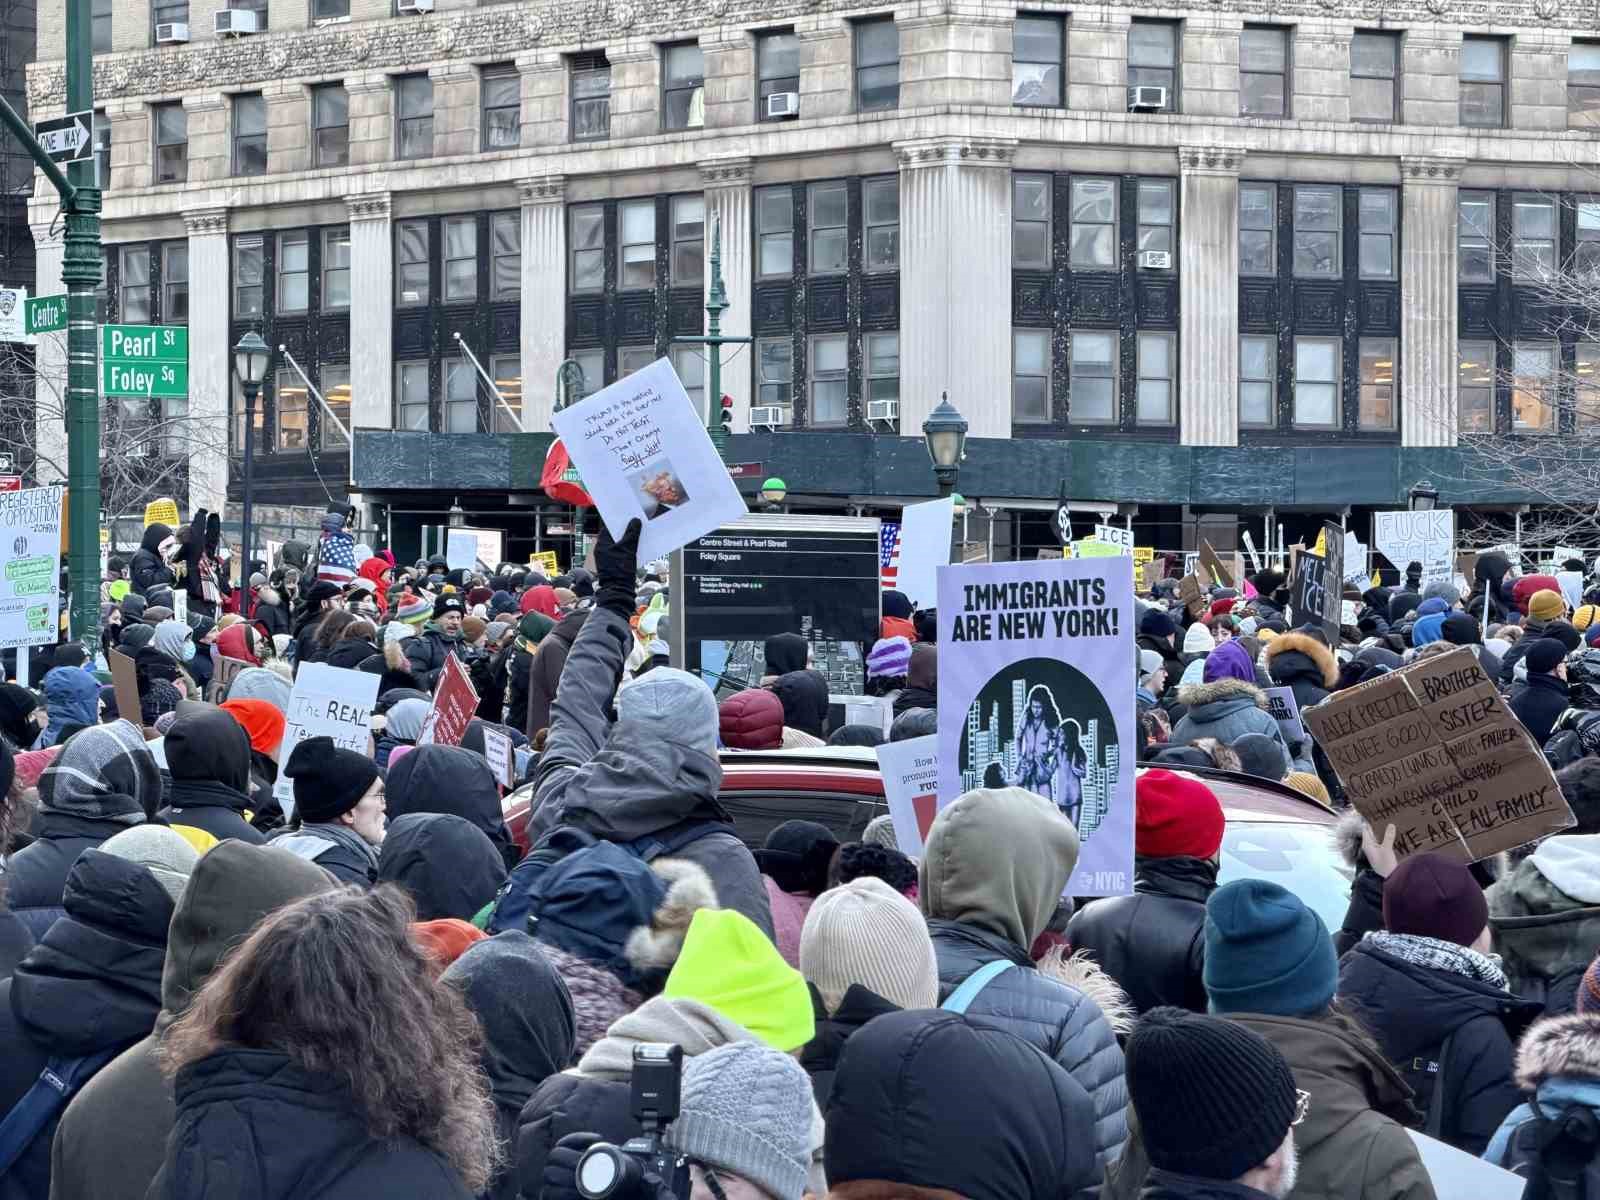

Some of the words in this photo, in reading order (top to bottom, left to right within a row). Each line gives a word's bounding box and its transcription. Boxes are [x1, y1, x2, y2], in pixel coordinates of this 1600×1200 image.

[40, 132, 57, 151] ONE
[64, 126, 81, 149] WAY
[32, 302, 59, 328] Centre
[60, 298, 67, 312] St
[112, 330, 156, 356] Pearl
[164, 330, 175, 345] St
[112, 366, 155, 396] Foley
[161, 366, 175, 384] Sq
[1100, 528, 1129, 546] ICE
[1378, 512, 1449, 541] FUCK
[700, 538, 722, 547] Centre
[723, 539, 743, 547] Street
[743, 539, 749, 547] &
[750, 540, 767, 548] Pearl
[767, 540, 788, 548] Street
[700, 552, 717, 562] Foley
[718, 552, 742, 562] Square
[1390, 540, 1437, 567] ICE
[964, 578, 1106, 612] IMMIGRANTS
[952, 615, 992, 642] ARE
[998, 612, 1046, 640] NEW
[1053, 608, 1118, 638] YORK!
[296, 696, 320, 718] The
[327, 700, 367, 727] REAL
[1268, 709, 1294, 721] ORK!
[1321, 709, 1361, 741] ALEX
[1356, 691, 1418, 727] PRETTI
[1422, 666, 1486, 702] BROTHER
[1332, 735, 1385, 765] RENEE
[1386, 721, 1431, 749] GOOD
[1440, 696, 1502, 731] SISTER
[1480, 728, 1522, 751] FATHER
[914, 757, 933, 768] How
[1431, 788, 1480, 817] CHILD
[1393, 826, 1423, 857] WE
[1427, 815, 1470, 843] ARE
[1469, 805, 1498, 830] ALL
[1095, 872, 1125, 890] NYIC
